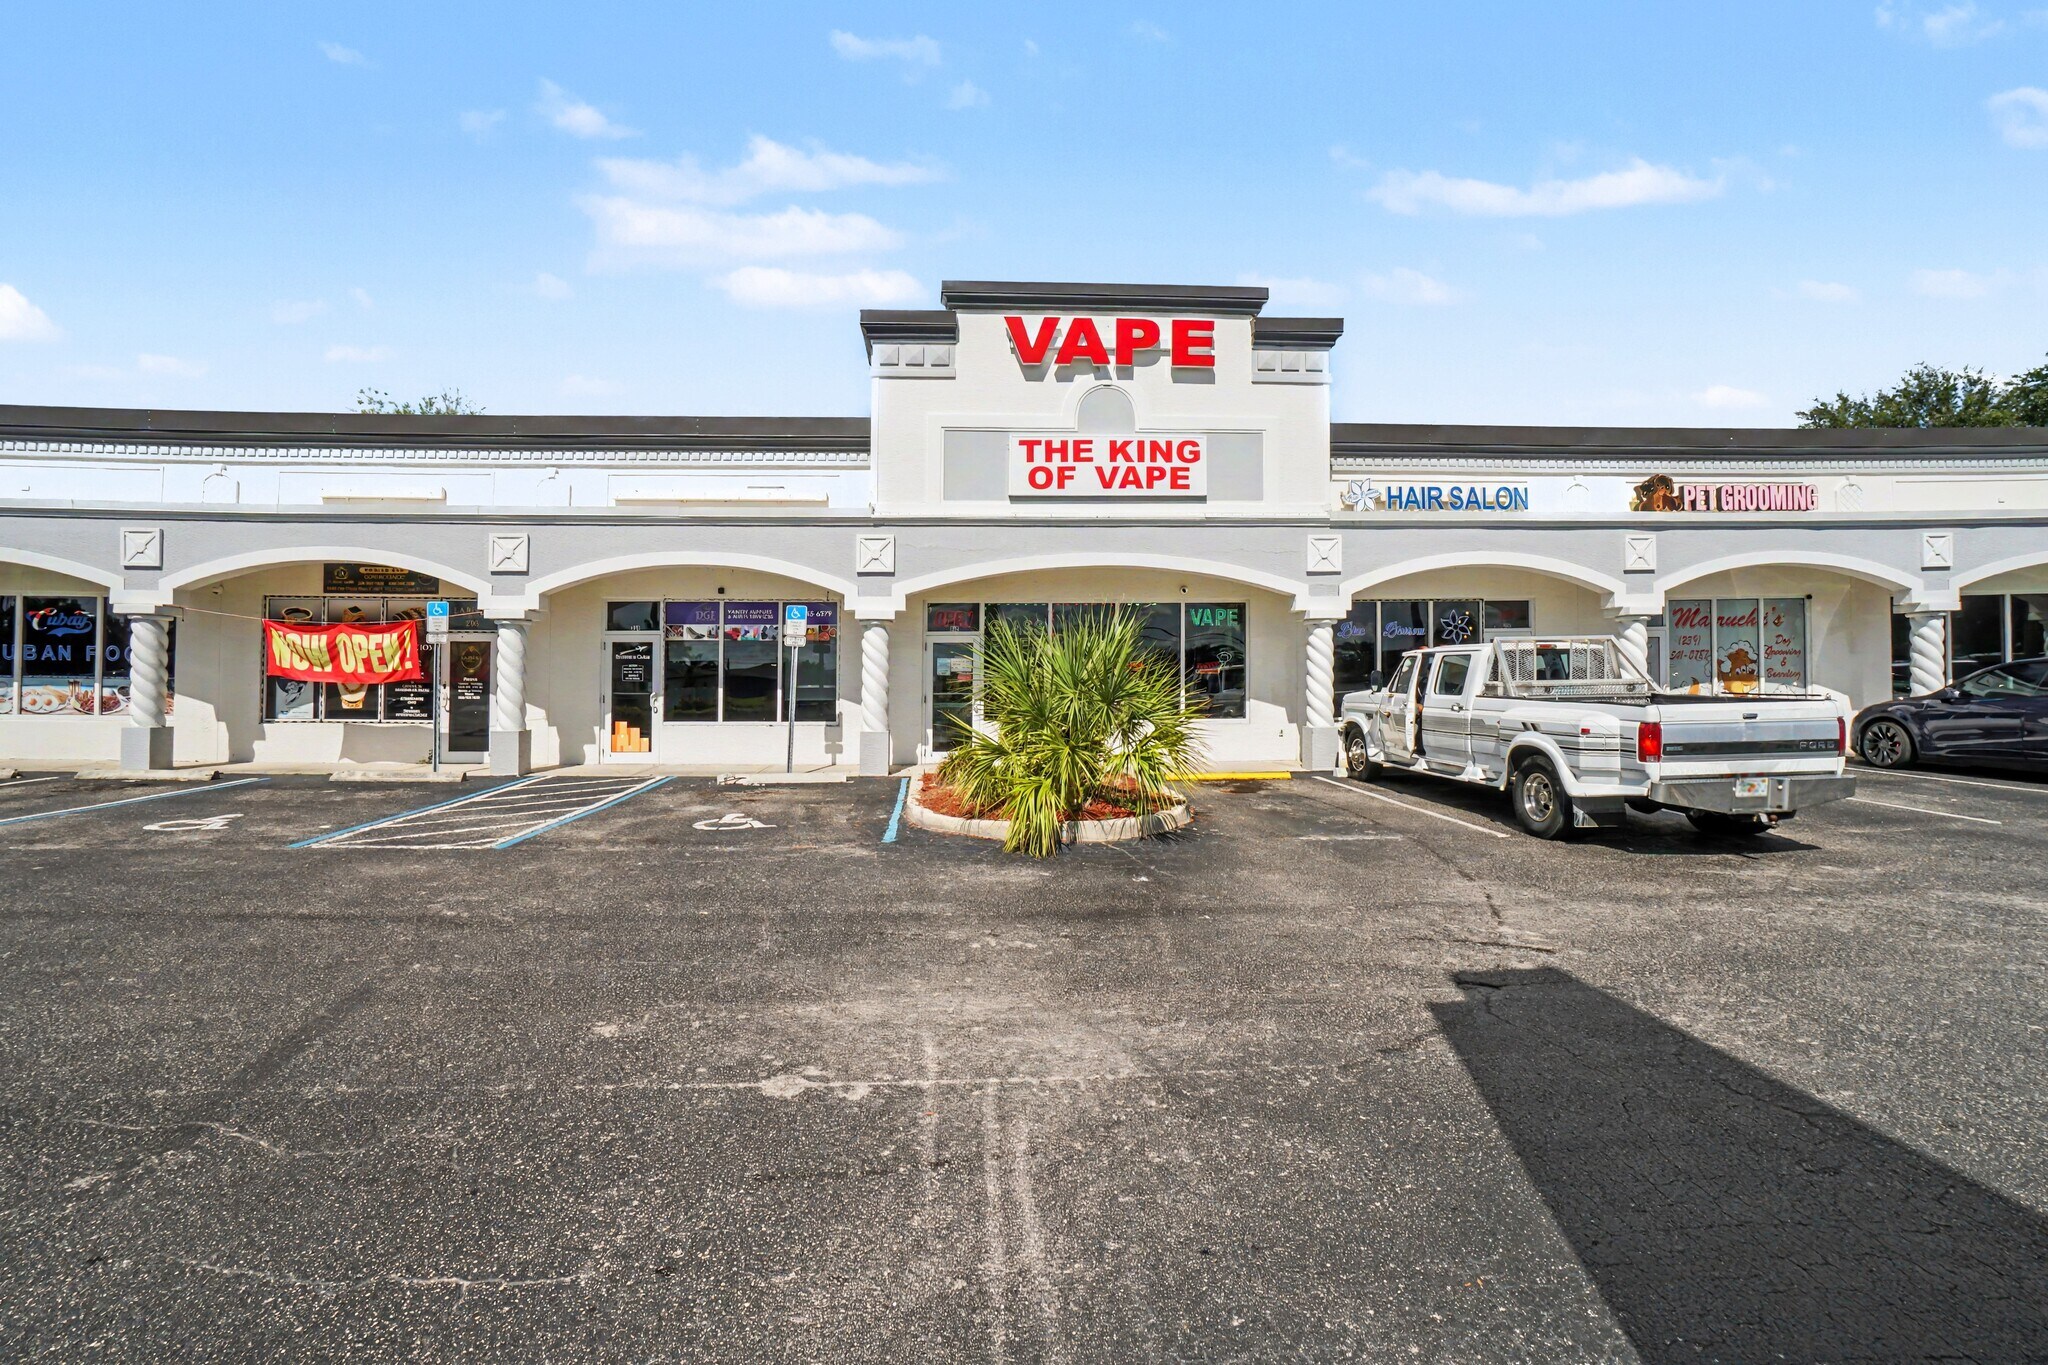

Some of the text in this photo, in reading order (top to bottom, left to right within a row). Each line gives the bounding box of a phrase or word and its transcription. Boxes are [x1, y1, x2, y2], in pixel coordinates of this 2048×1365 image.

[1004, 316, 1216, 368] VAPE
[1018, 439, 1201, 464] THE KING
[1027, 465, 1191, 490] OF VAPE
[1386, 486, 1444, 510] HAIR
[1449, 486, 1529, 511] SALON
[1683, 484, 1819, 511] PET GROOMING
[1190, 608, 1239, 626] VAPE
[270, 627, 414, 674] NOW OPEN!
[1800, 741, 1835, 749] FORD
